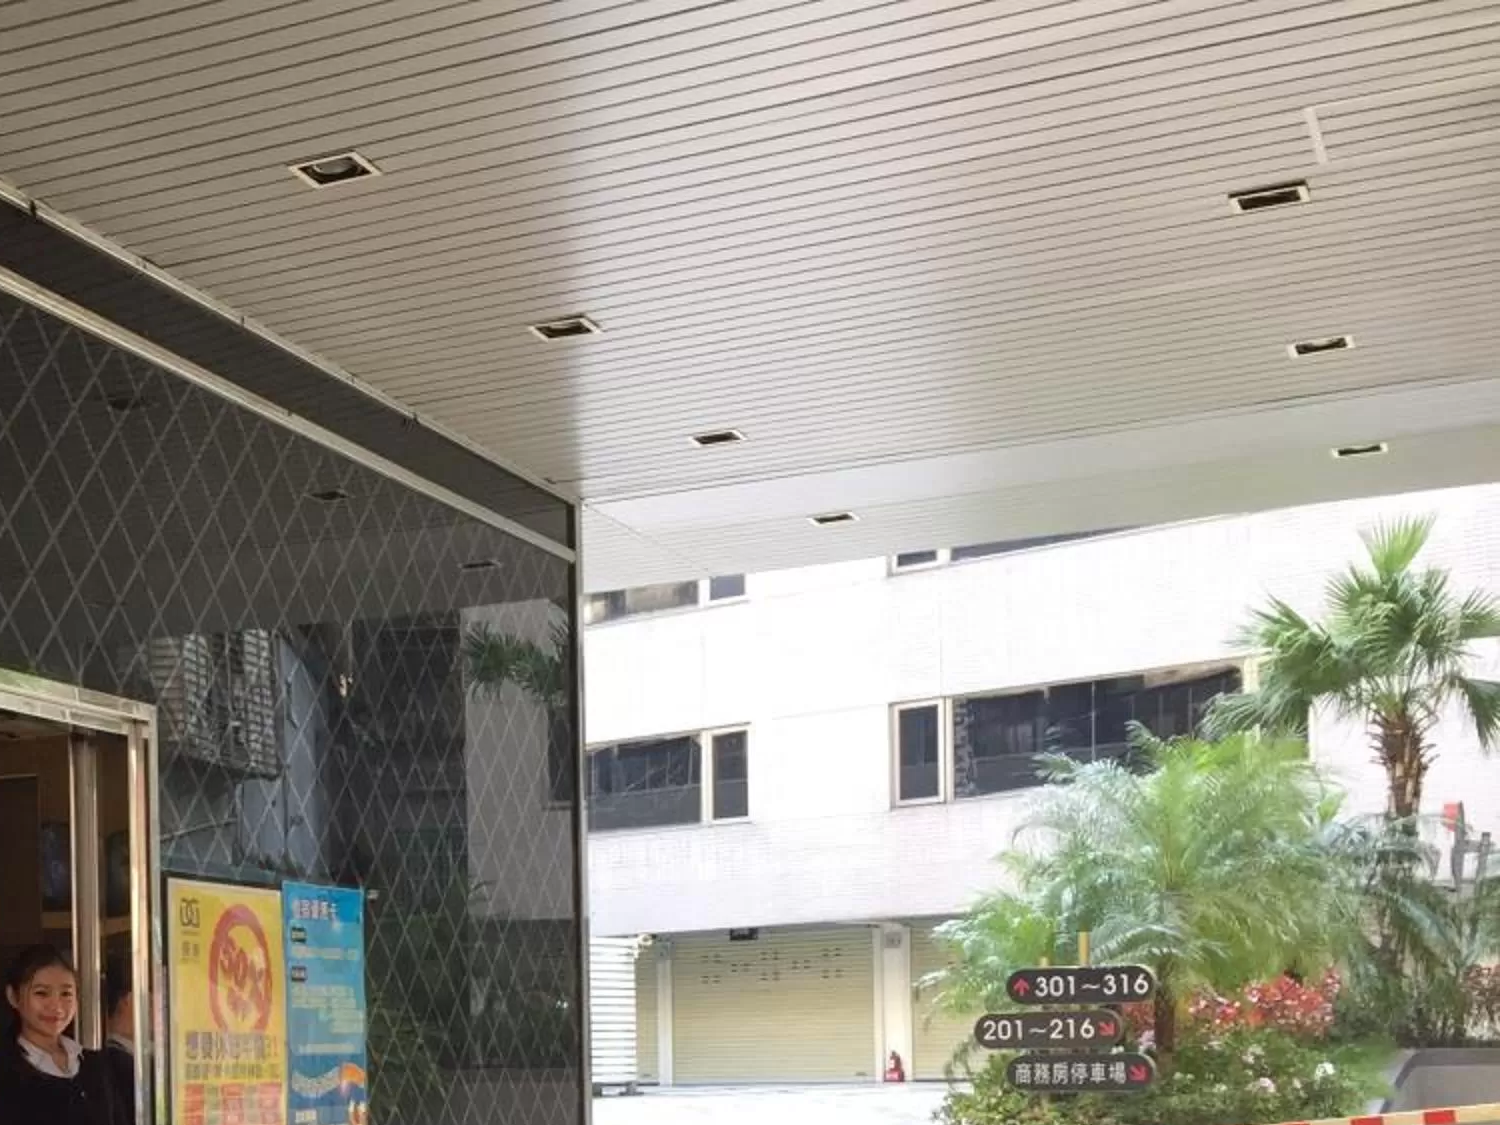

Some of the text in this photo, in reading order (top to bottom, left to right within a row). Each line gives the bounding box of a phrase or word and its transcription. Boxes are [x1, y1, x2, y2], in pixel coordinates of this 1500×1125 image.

[1015, 1061, 1127, 1085] 商務房停車場
